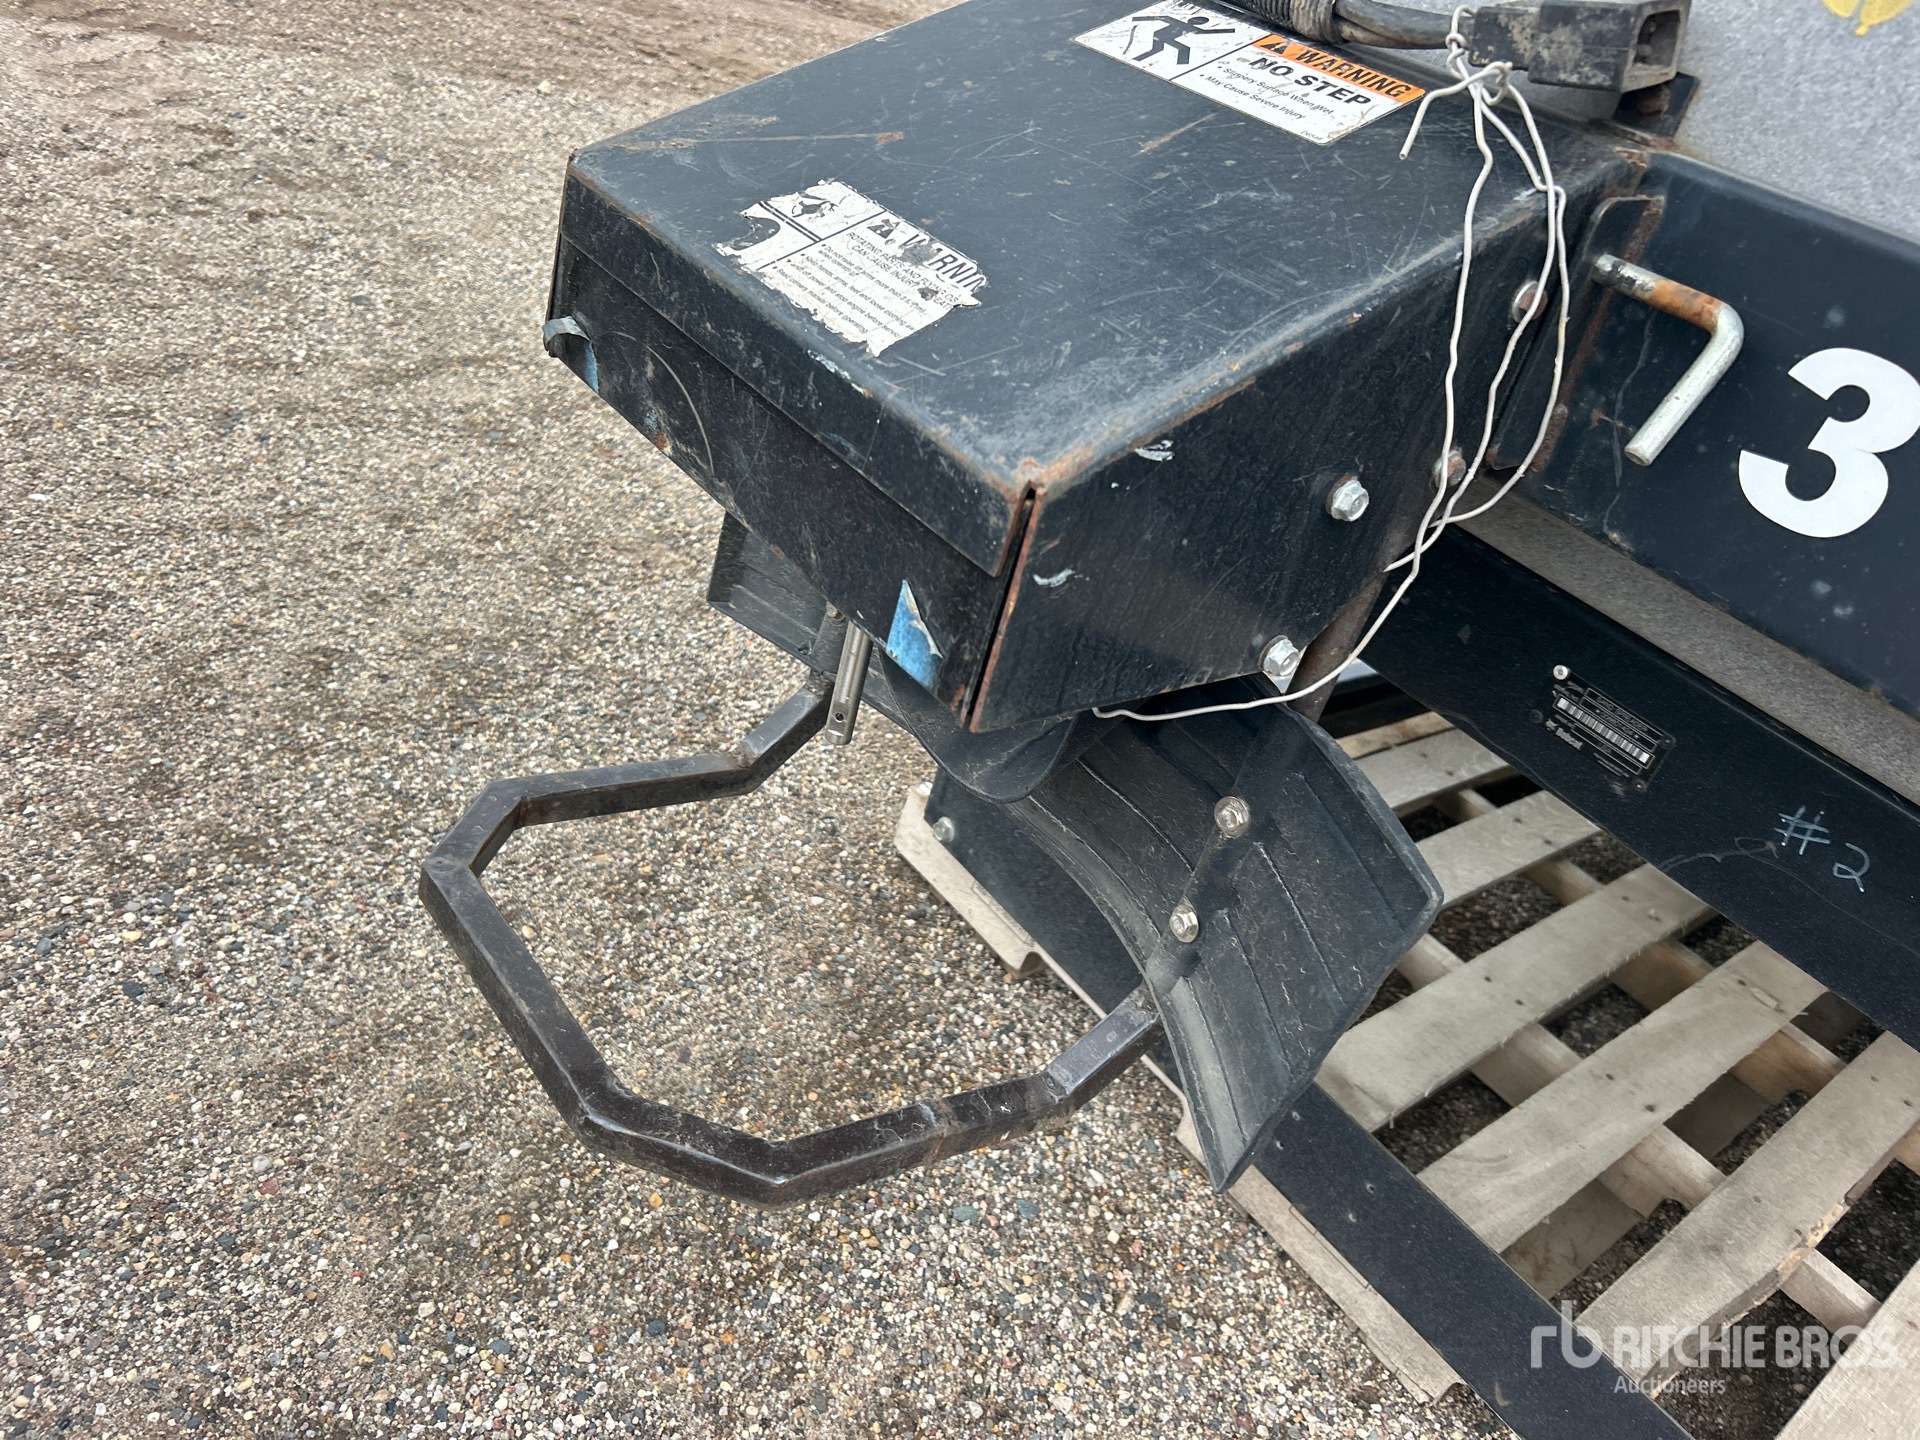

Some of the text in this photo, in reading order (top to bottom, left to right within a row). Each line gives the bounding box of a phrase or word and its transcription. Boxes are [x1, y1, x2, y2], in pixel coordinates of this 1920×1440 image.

[1204, 75, 1307, 120] May Cause Severe Injury
[1223, 68, 1335, 115] Slippery Surface When Wet
[1249, 57, 1372, 106] NO STEP
[1295, 49, 1412, 98] WARNING
[846, 232, 882, 254] ROTATING
[903, 267, 921, 280] AND
[852, 245, 869, 257] CAN
[867, 255, 893, 272] CAUSE
[1739, 347, 1920, 538] 3
